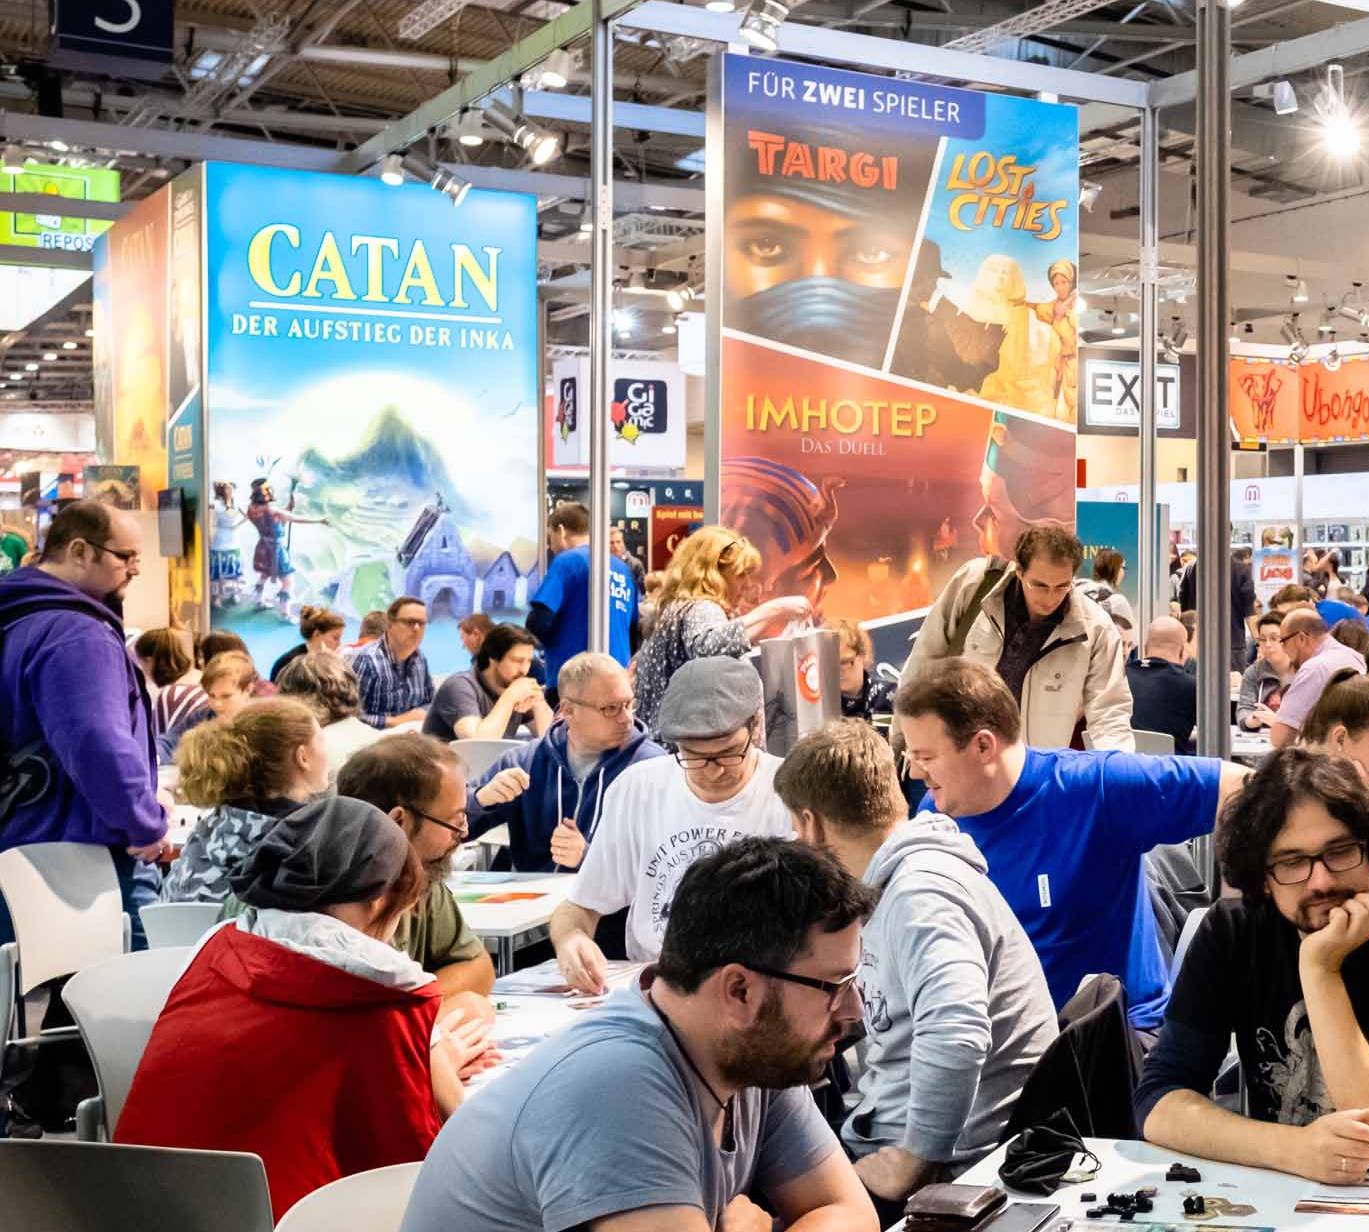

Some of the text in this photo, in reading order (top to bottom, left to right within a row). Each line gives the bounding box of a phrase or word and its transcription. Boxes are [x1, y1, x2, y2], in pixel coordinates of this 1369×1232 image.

[748, 72, 960, 123] FÜR ZWEI SPIELER
[747, 129, 898, 191] TARGI
[946, 150, 1038, 196] LOST
[949, 190, 1067, 240] CITIES
[248, 223, 503, 312] CATAN
[232, 314, 515, 350] DER AUFSTIEG DER INKA
[746, 394, 938, 437] IMHOTEP
[1092, 372, 1176, 412] EXT
[645, 843, 668, 879] UNIT
[669, 827, 727, 848] POWER
